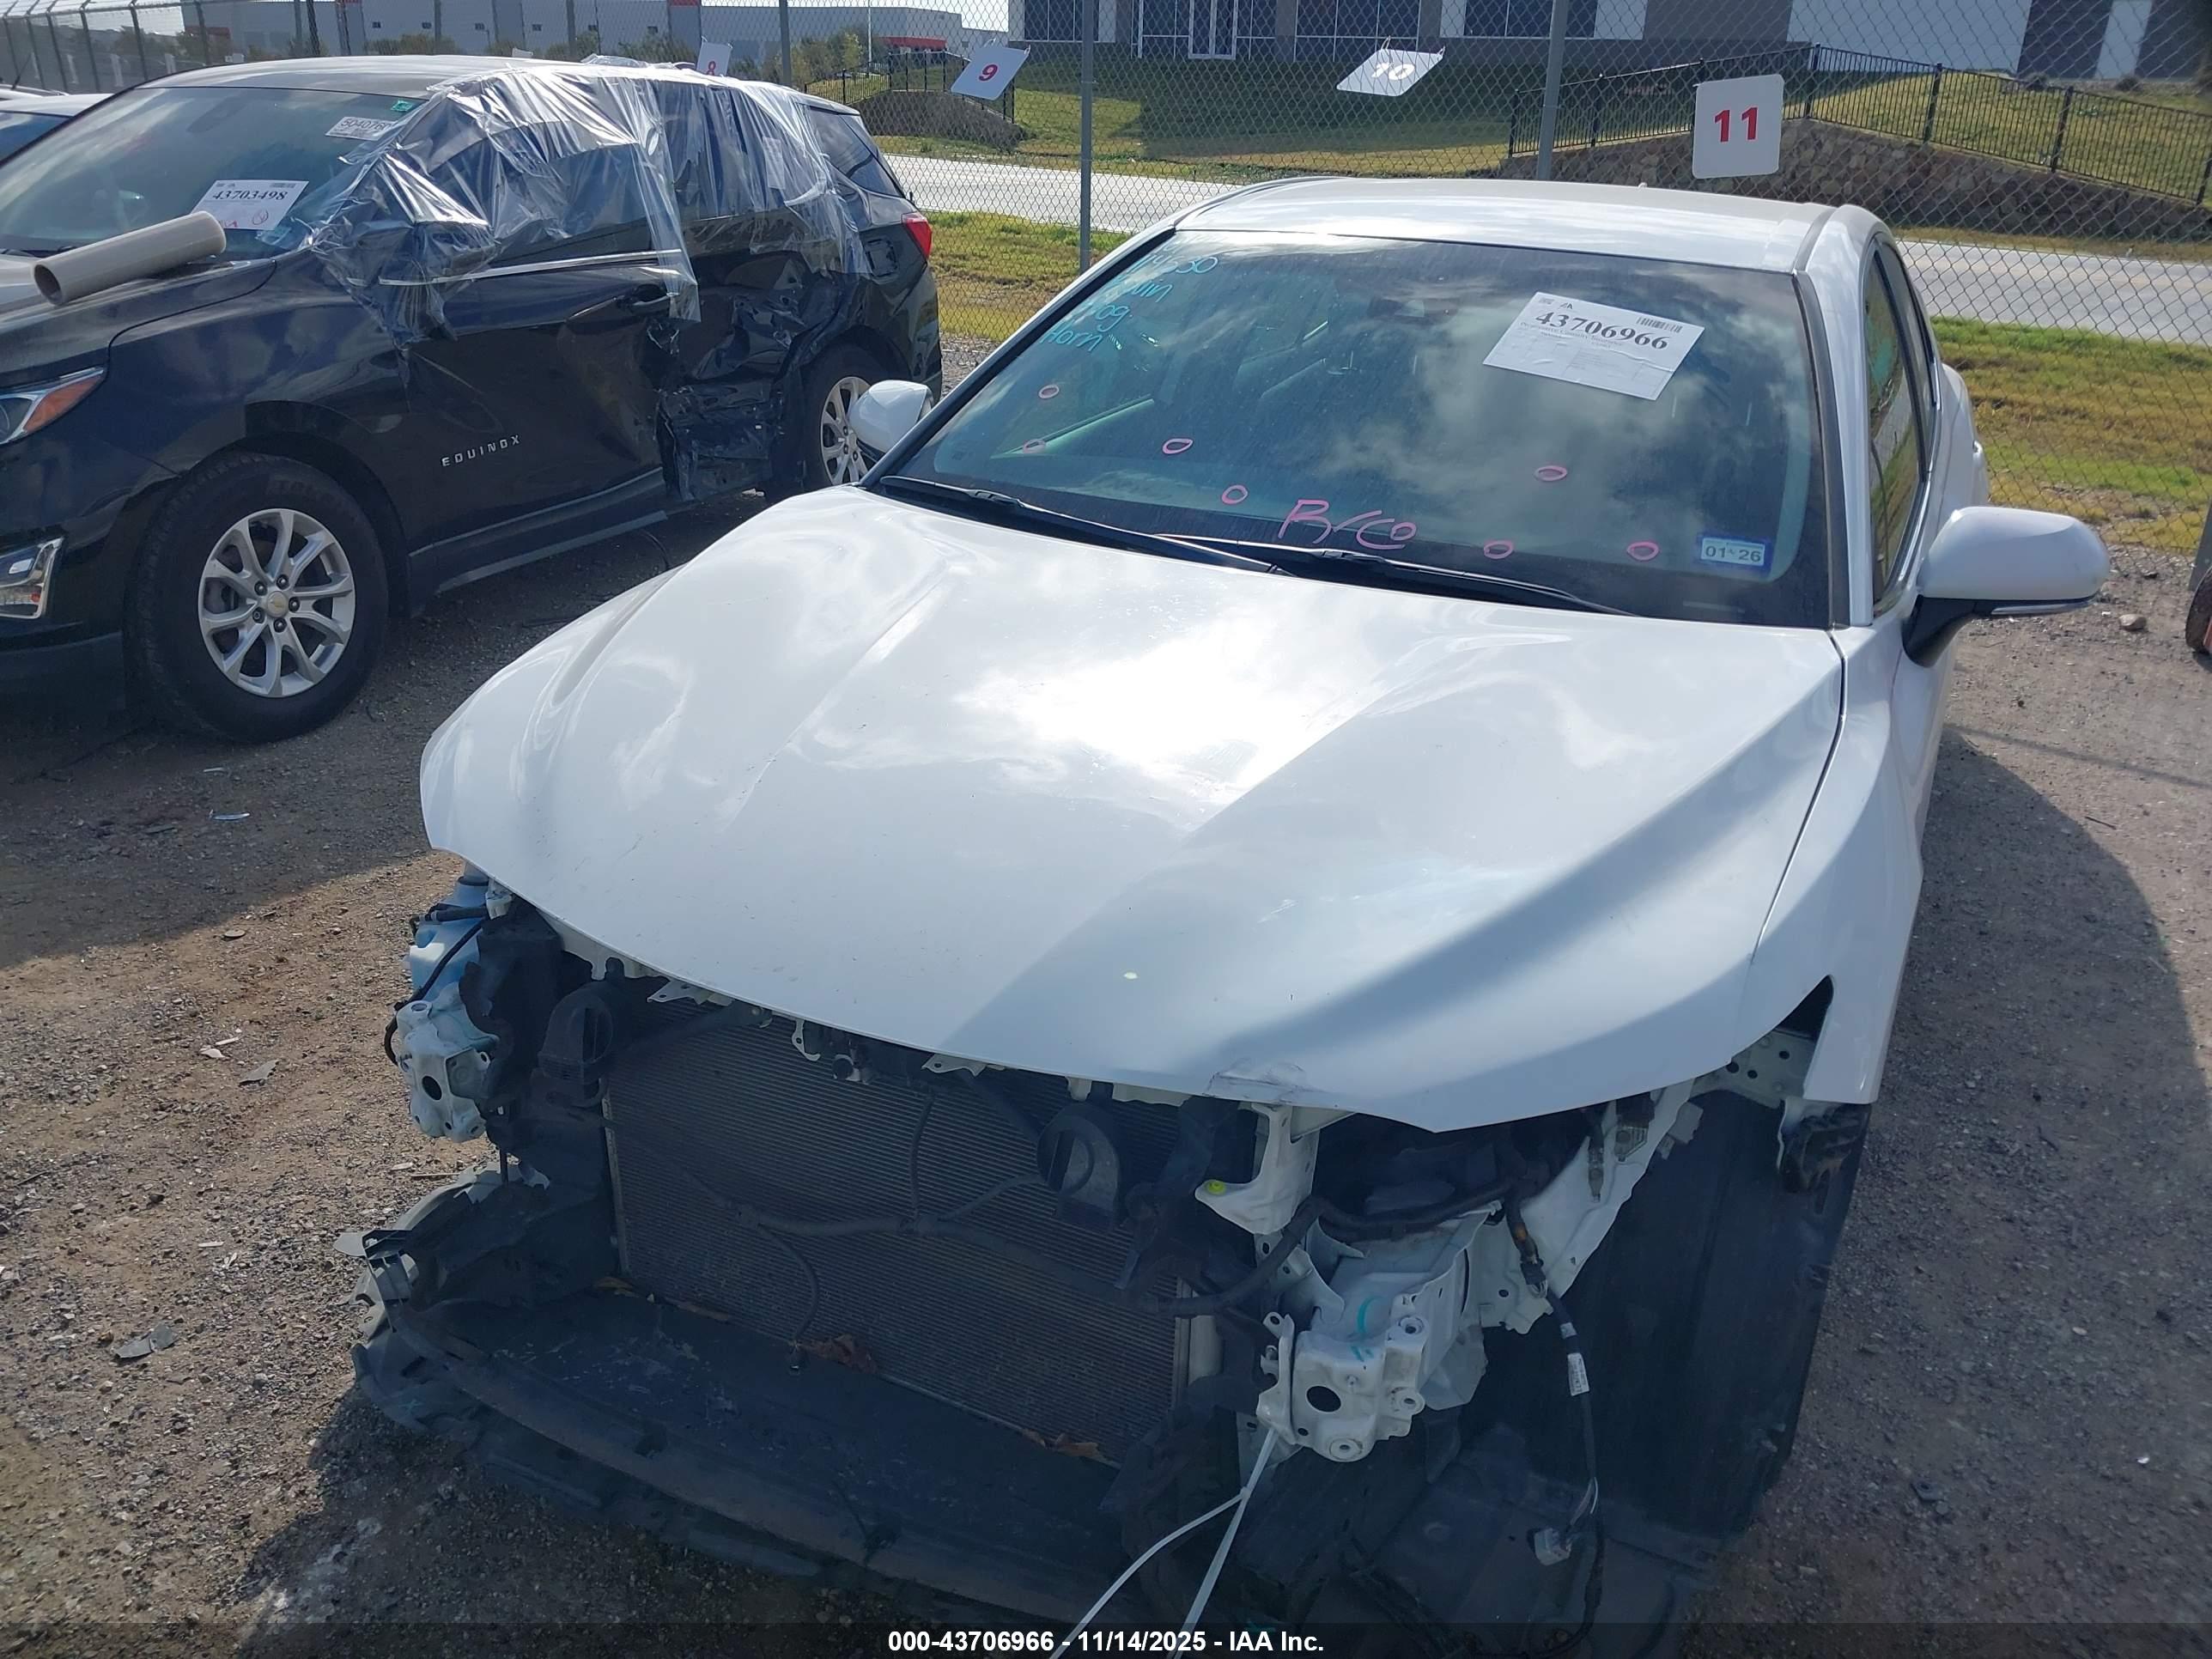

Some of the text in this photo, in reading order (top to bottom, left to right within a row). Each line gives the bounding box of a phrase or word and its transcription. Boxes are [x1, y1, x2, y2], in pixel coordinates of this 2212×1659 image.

[706, 60, 716, 76] 8
[979, 64, 998, 82] 9
[1370, 62, 1416, 81] 10
[1714, 106, 1759, 143] 11
[212, 190, 288, 200] 43703498
[1535, 311, 1671, 350] 43706966
[441, 434, 520, 467] EQUINOX
[1705, 545, 1761, 562] 01 26
